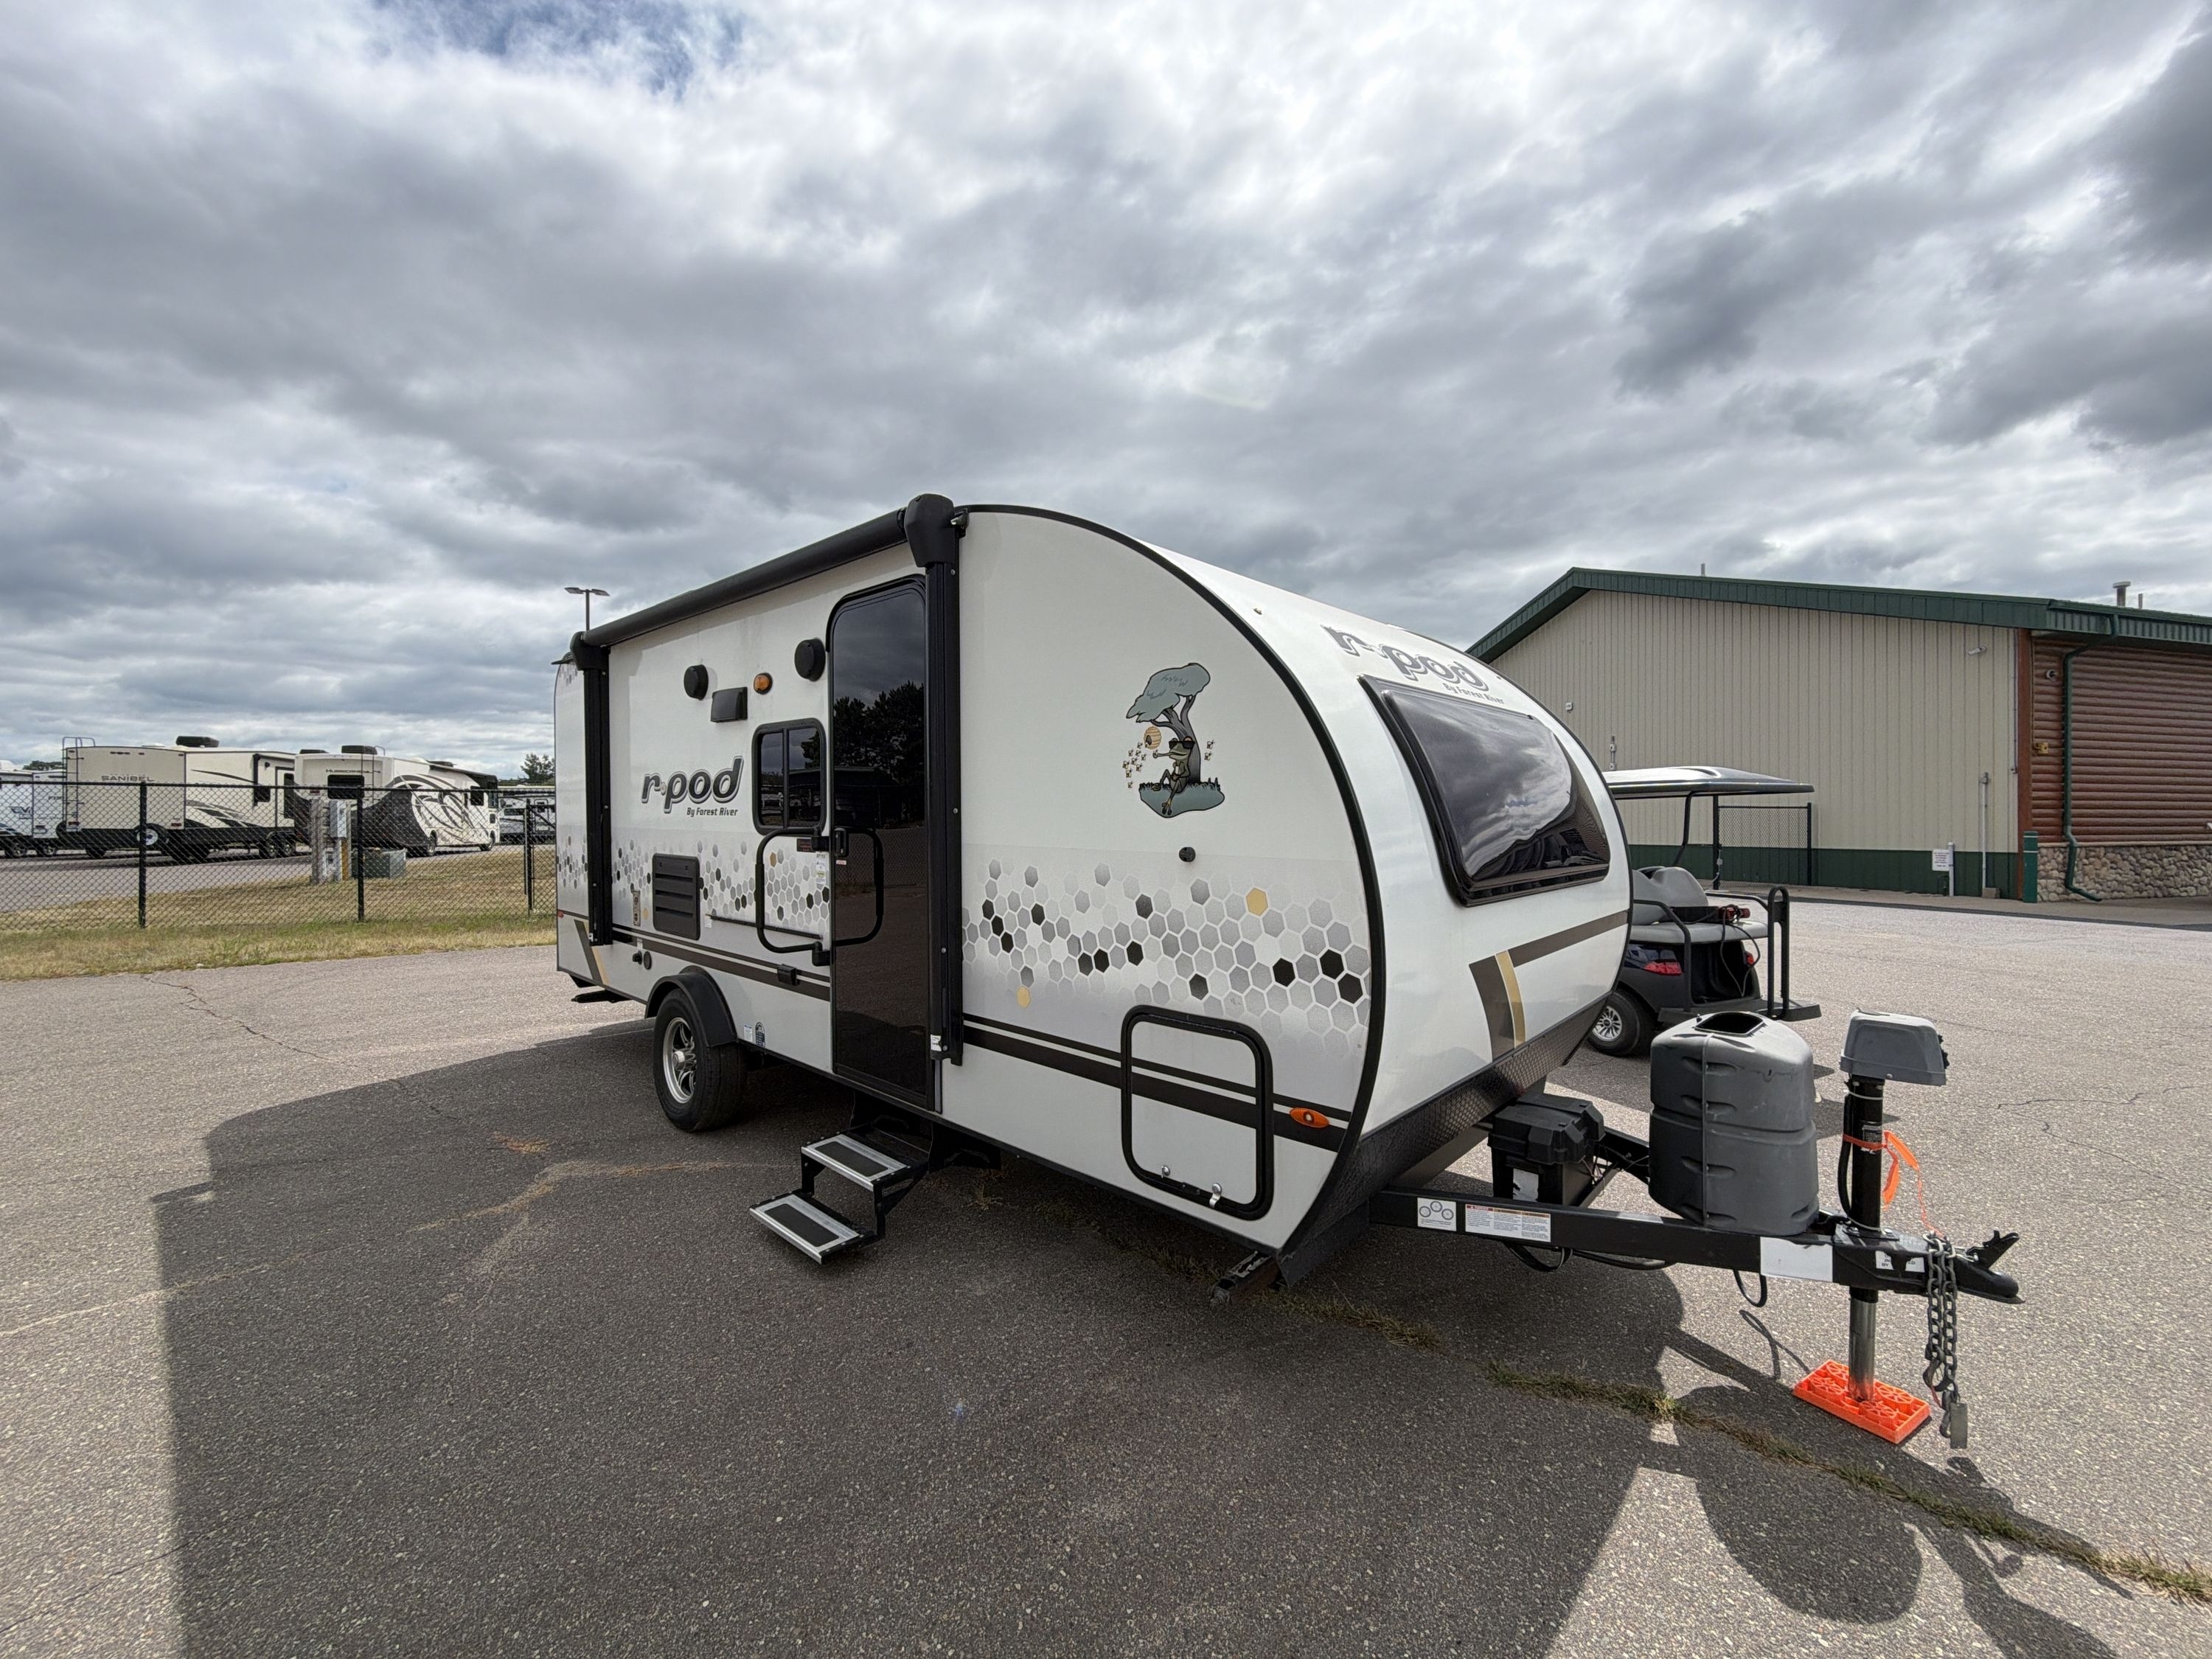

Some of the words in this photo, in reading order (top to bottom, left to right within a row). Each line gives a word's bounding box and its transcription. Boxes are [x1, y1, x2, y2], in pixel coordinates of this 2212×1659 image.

[686, 807, 695, 817] By
[696, 807, 717, 816] Forest
[719, 807, 738, 816] River
